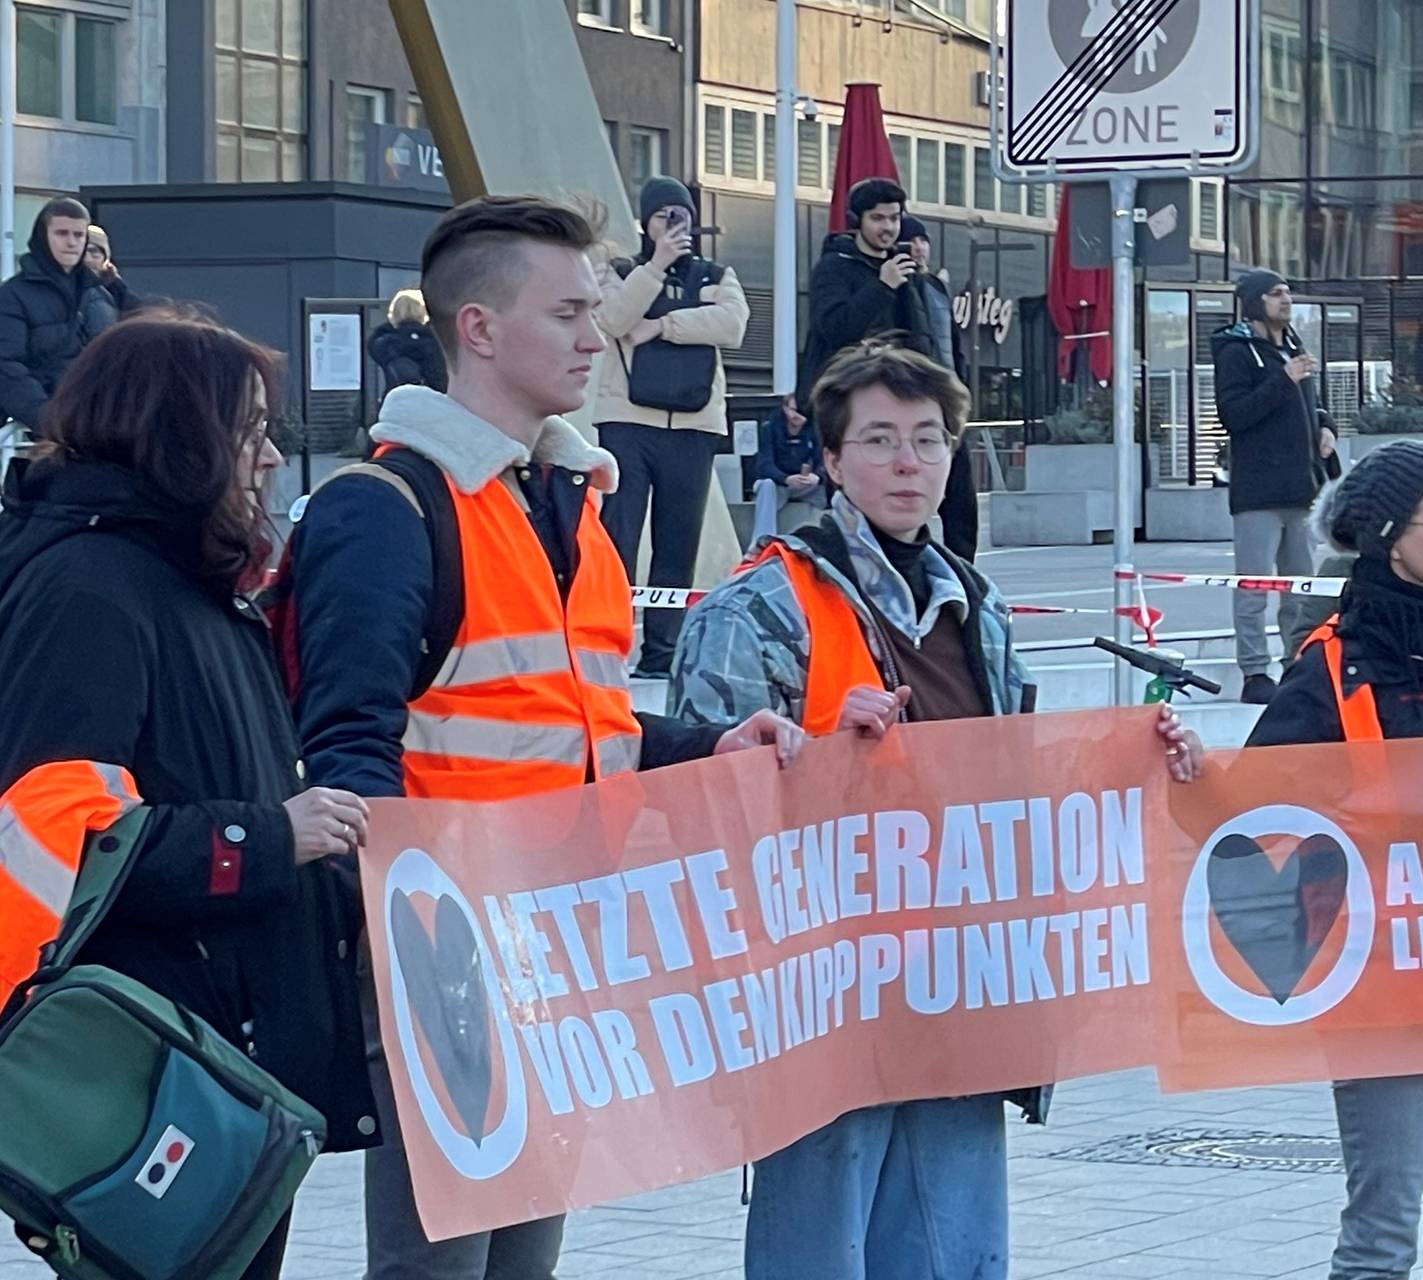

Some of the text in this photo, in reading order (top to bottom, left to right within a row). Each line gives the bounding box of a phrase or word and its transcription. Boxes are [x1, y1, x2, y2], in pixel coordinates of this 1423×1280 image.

[1066, 105, 1179, 146] ZONE
[483, 787, 1146, 1003] LETZTE GENERATION
[516, 1010, 655, 1115] VOR
